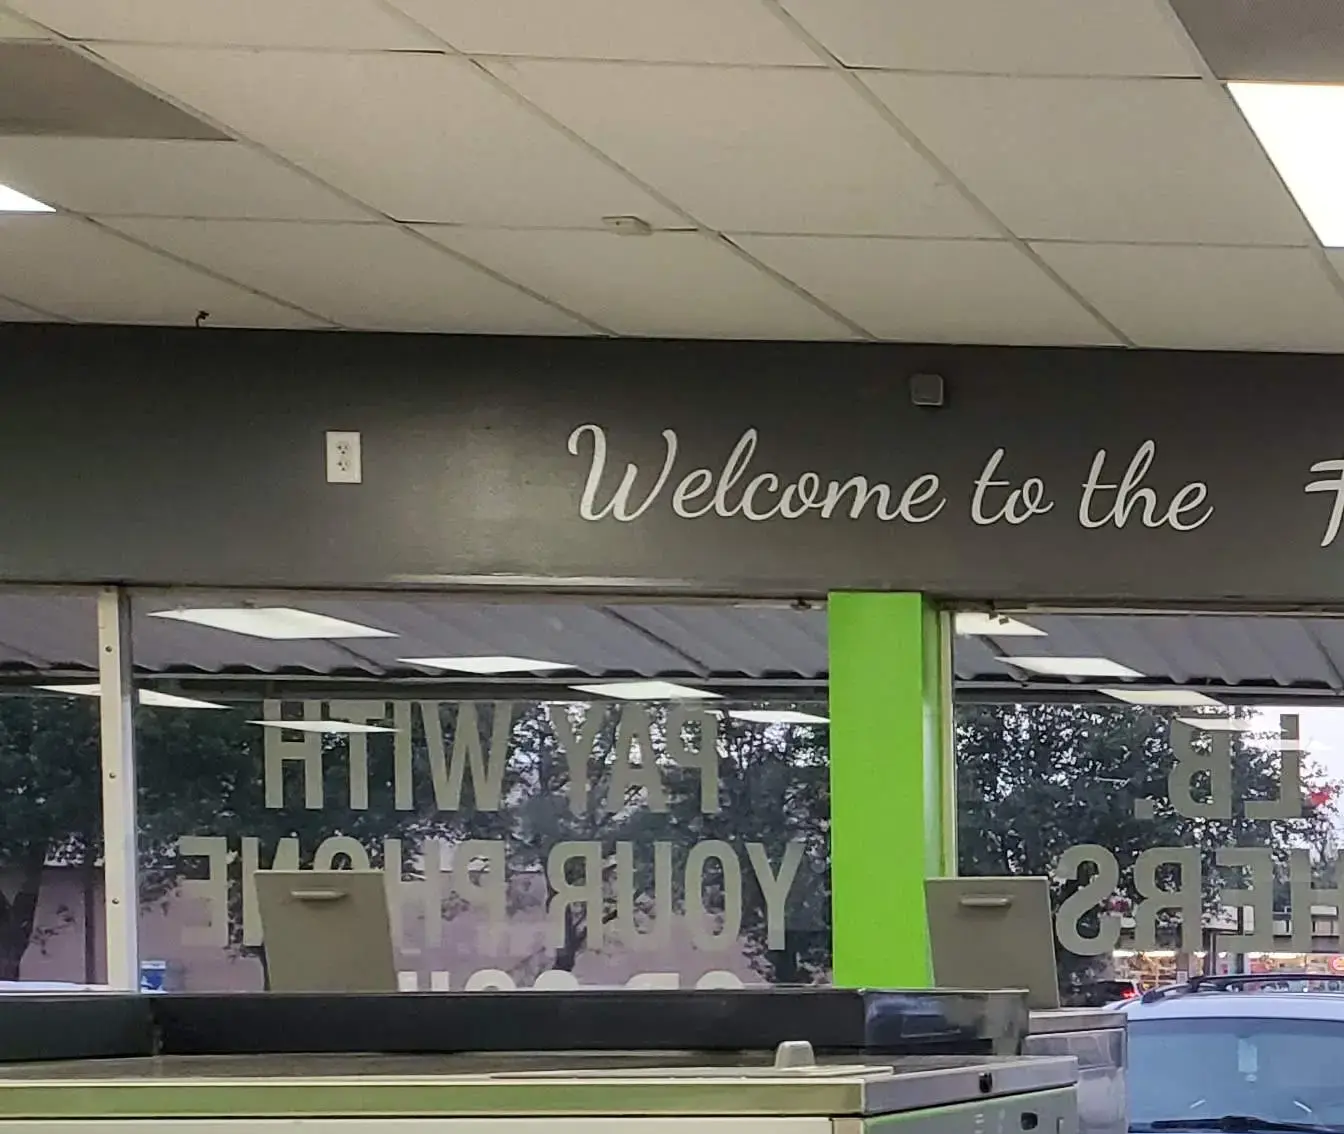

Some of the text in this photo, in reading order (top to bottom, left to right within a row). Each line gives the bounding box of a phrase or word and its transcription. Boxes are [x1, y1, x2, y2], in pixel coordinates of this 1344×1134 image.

[567, 425, 947, 522] Welcome
[970, 448, 1054, 526] to
[1078, 439, 1215, 531] the
